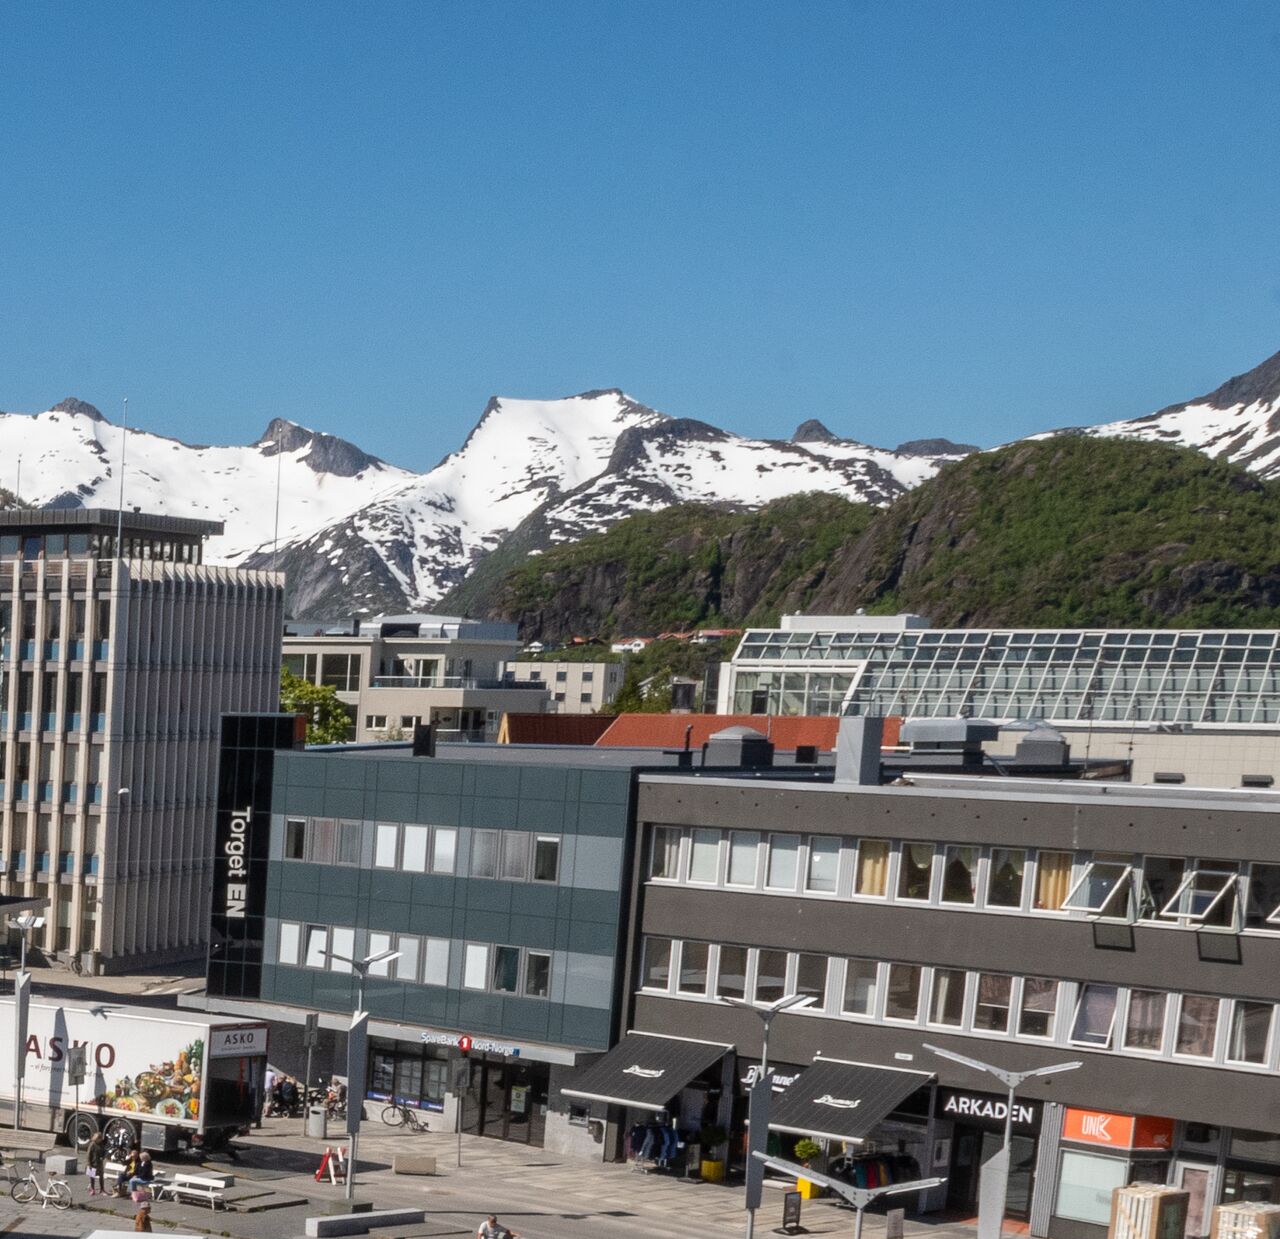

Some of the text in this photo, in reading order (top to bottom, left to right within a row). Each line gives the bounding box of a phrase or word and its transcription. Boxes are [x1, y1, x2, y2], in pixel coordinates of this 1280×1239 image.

[225, 806, 251, 918] Torget EN
[224, 1032, 254, 1045] ASKO
[421, 1032, 459, 1047] SpareBank
[944, 1096, 1034, 1124] ARKADEN
